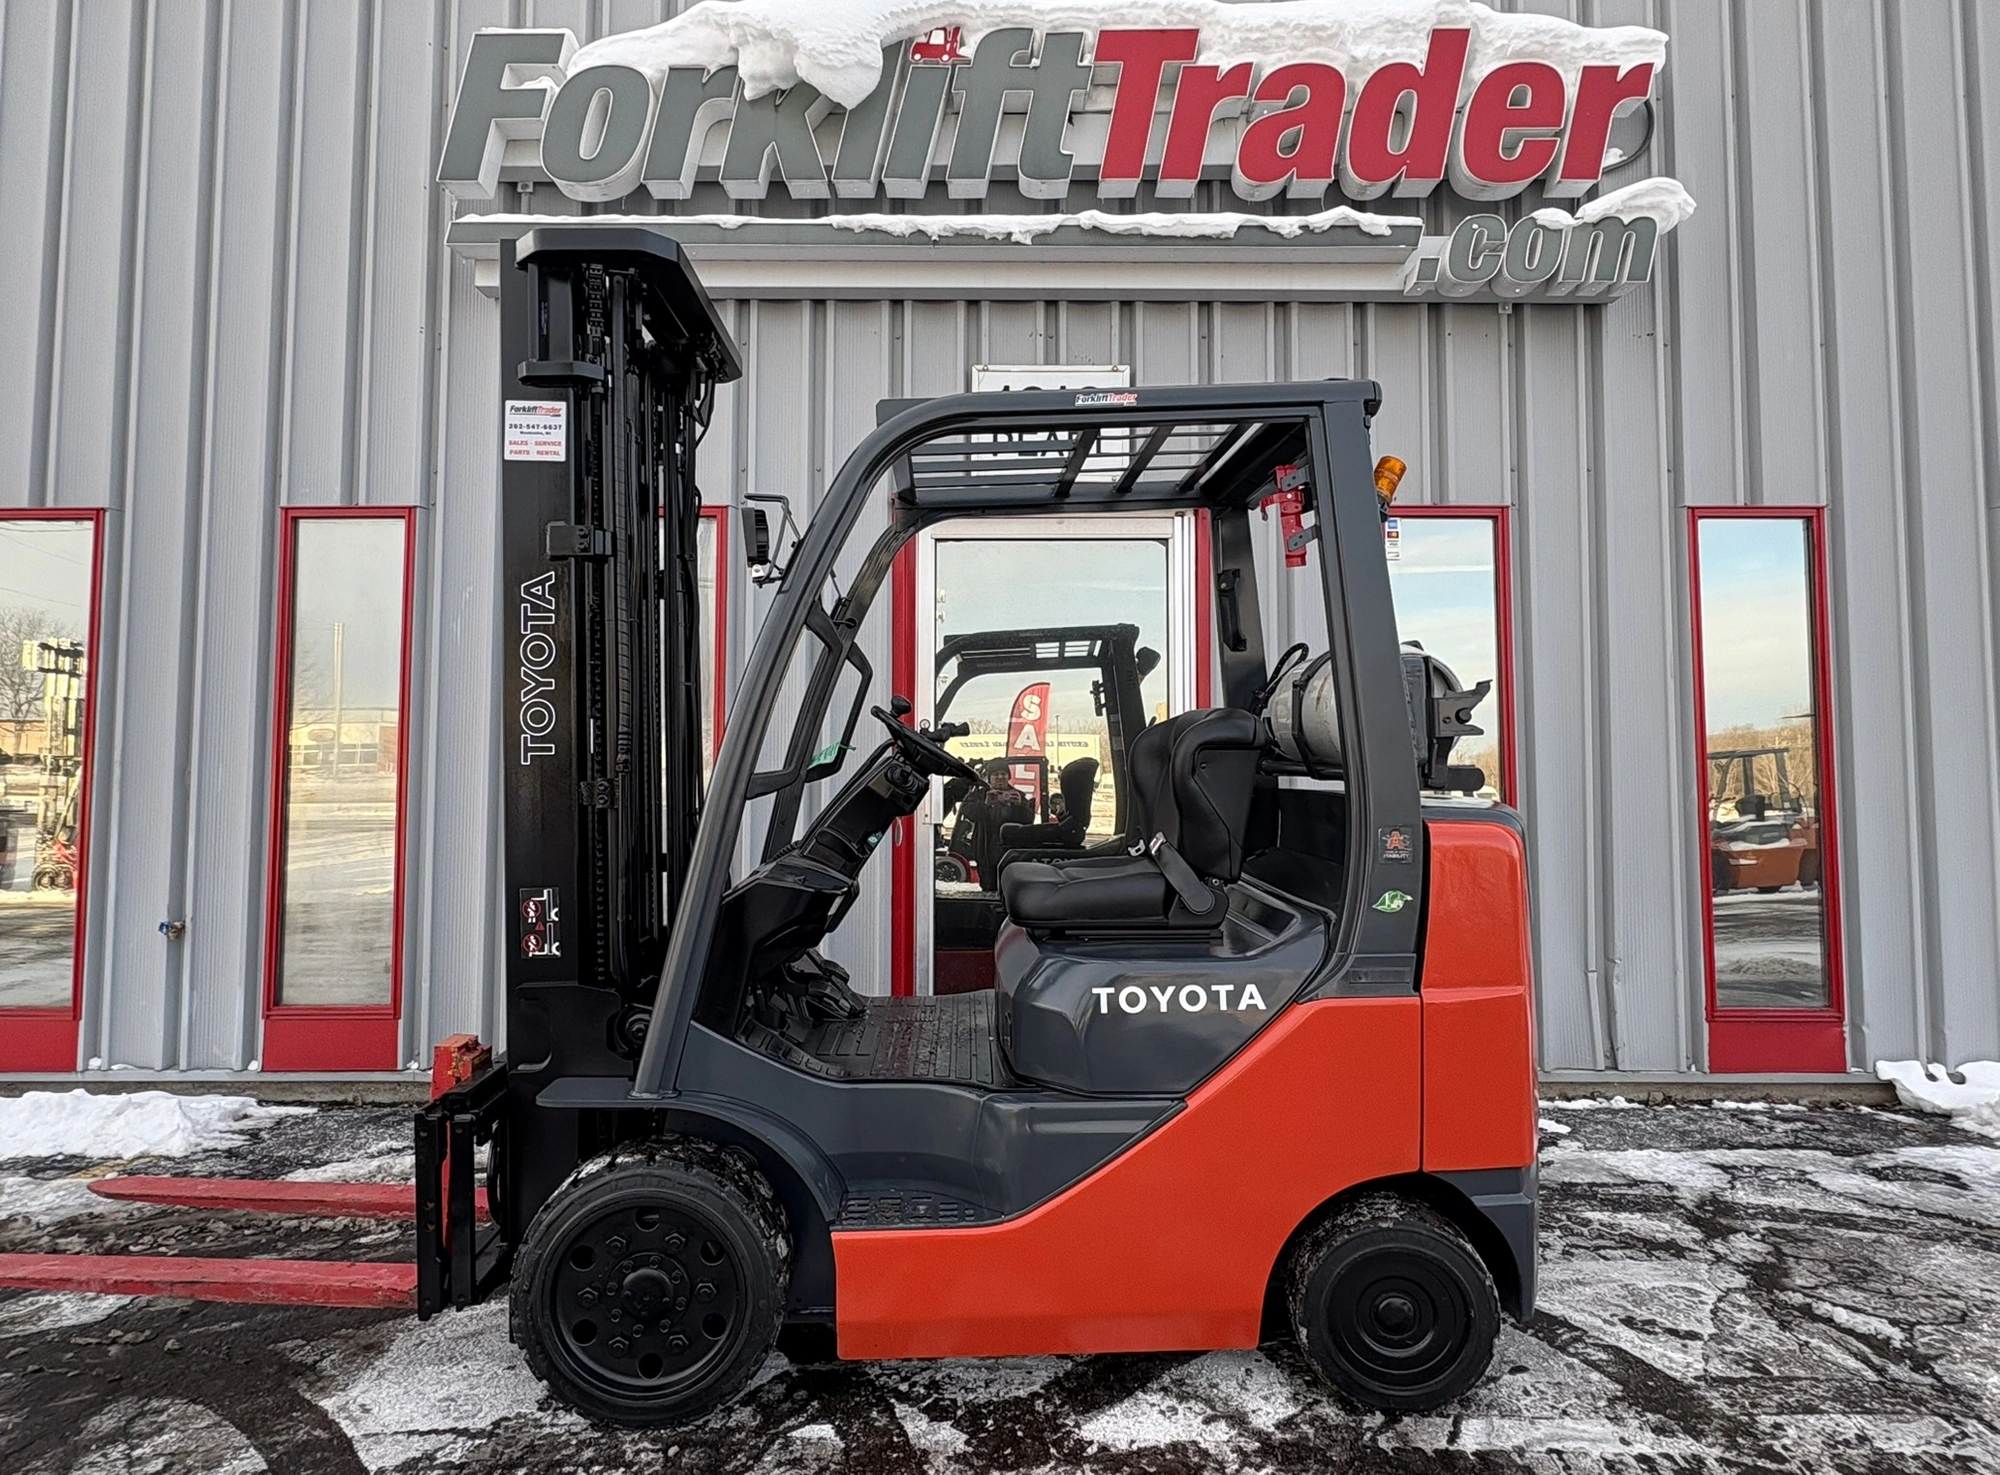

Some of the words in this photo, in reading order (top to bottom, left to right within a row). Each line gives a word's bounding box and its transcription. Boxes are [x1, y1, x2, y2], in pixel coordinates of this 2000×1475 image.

[436, 27, 1656, 184] ForkliftTrader
[1414, 212, 1659, 284] .com
[509, 405, 562, 414] ForkliftTrader
[1076, 392, 1138, 403] ForkliftTrader
[519, 571, 556, 766] TOYOTA
[1091, 983, 1267, 1014] TOYOTA
